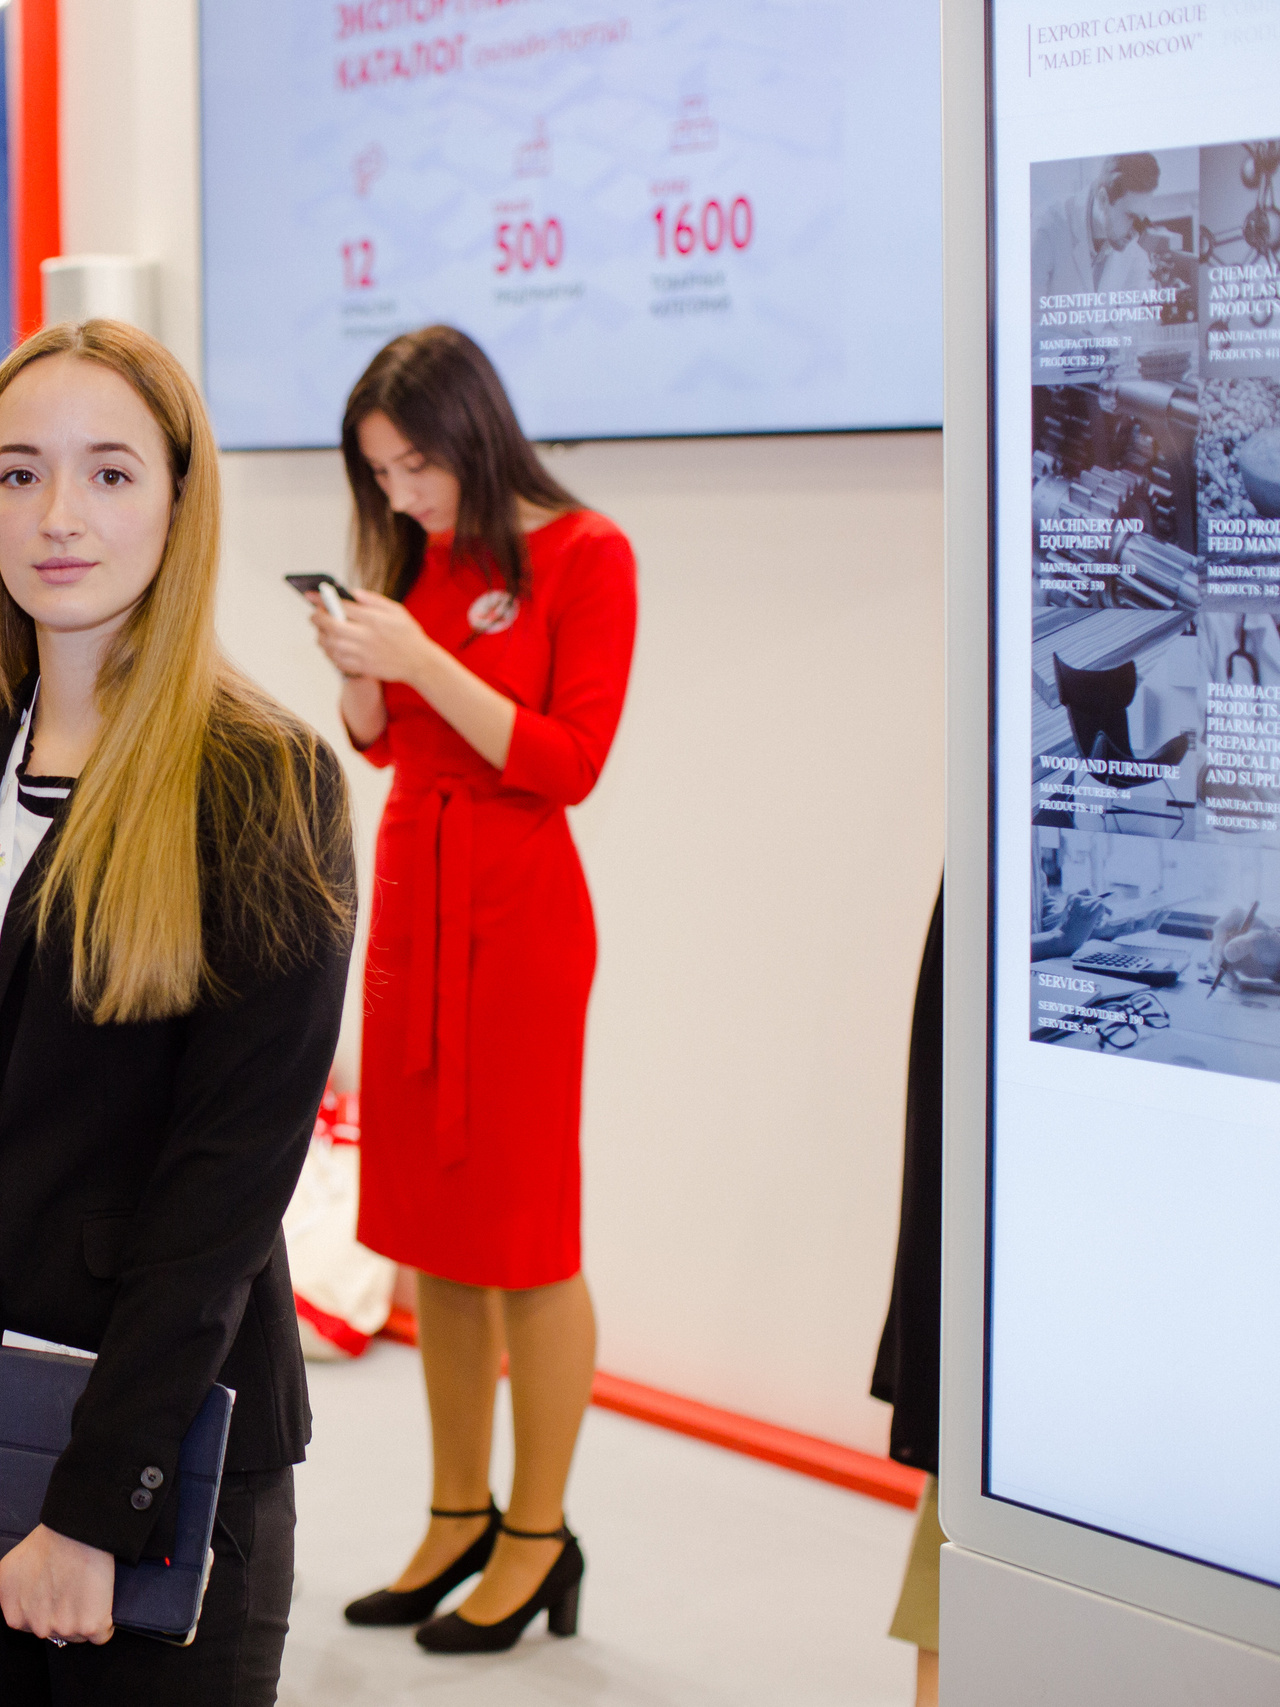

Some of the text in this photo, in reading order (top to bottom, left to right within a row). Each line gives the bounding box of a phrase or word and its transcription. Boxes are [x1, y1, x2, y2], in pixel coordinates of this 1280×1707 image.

[1038, 20, 1101, 44] EXPORT
[1104, 4, 1207, 34] CATALOGUE
[1038, 49, 1092, 70] "MADE
[1097, 46, 1113, 63] IN
[1119, 32, 1203, 61] MOSCOW"
[652, 195, 753, 258] 1600
[494, 217, 565, 276] 500
[341, 238, 376, 290] 12
[1040, 287, 1177, 309] SCIENTIFIC RESEARCH
[1209, 283, 1239, 300] AND
[1040, 305, 1163, 326] AND DEVELOPMENT
[1040, 355, 1089, 367] PRODUCTS:
[1040, 518, 1144, 533] MACHINERY AND
[1208, 518, 1246, 535] FOOD
[1040, 535, 1112, 551] EQUIPMENT
[1208, 536, 1243, 553] FEED
[1040, 562, 1120, 575] MANUFACTURERS:
[1040, 579, 1089, 591] PRODUCTS:
[1207, 583, 1262, 597] PRODUCTS:
[1207, 733, 1280, 752] PREPARATI
[1040, 755, 1180, 780] WOOD AND FURNITURE
[1207, 751, 1268, 770] MEDICAL
[1205, 768, 1280, 788] AND SUPPL
[1040, 782, 1119, 799] MANUFACTURERS:
[1040, 799, 1089, 813] PRODUCTS:
[1206, 814, 1260, 830] PRODUCTS:
[1038, 973, 1095, 993] SERVICES
[1038, 1000, 1075, 1015] SERVICE
[1075, 1005, 1128, 1023] PROVIDERS:
[1038, 1017, 1081, 1032] SERVICES:
